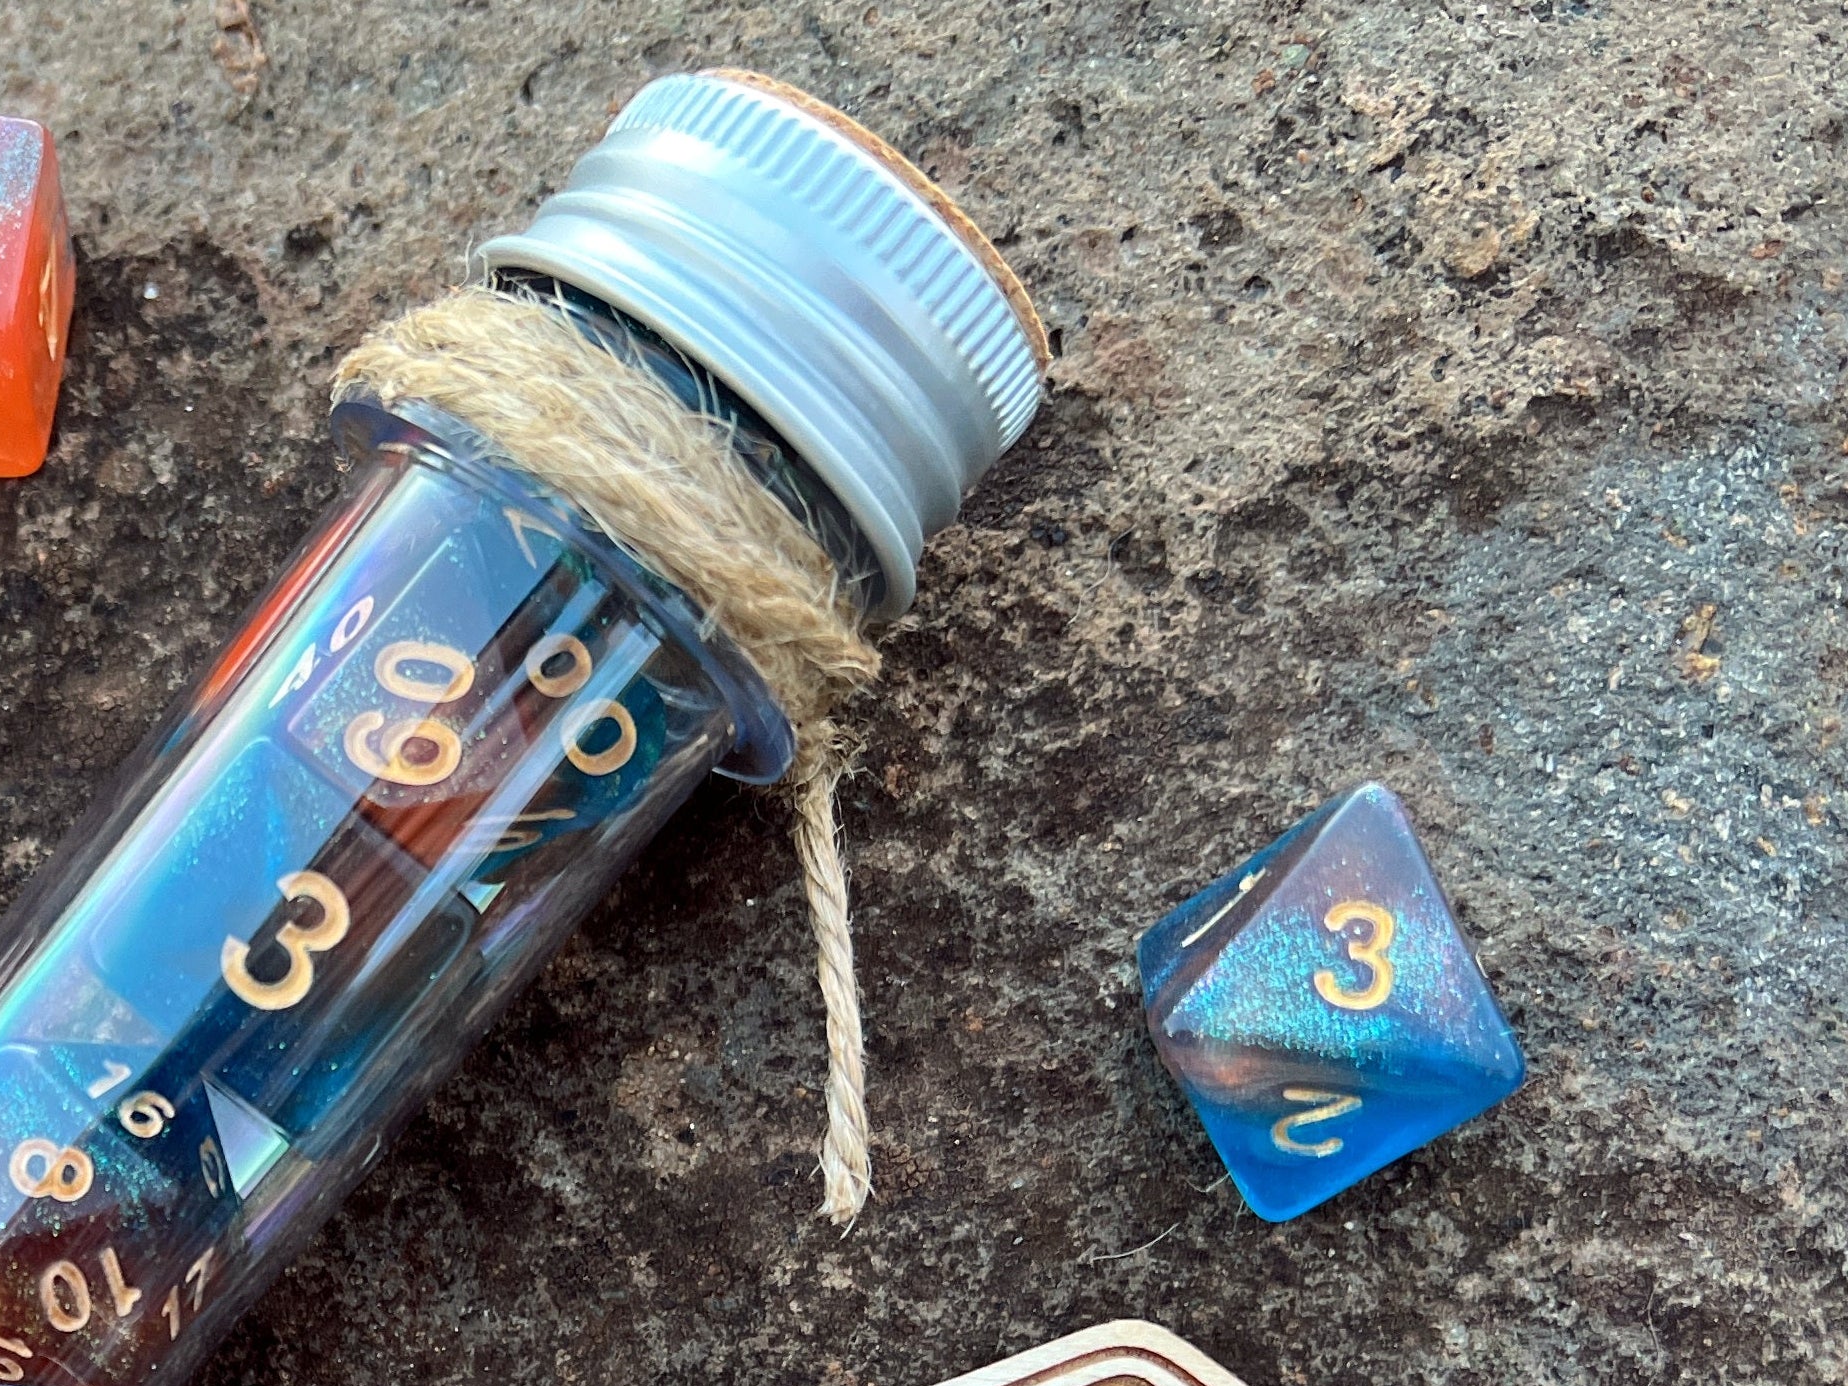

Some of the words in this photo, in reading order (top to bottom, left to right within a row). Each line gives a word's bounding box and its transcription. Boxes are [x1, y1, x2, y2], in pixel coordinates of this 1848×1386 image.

[344, 640, 475, 787] 60
[221, 870, 351, 1011] 3
[1313, 900, 1394, 1010] 3
[9, 1138, 95, 1203] 8
[1270, 1087, 1362, 1157] 2
[41, 1247, 142, 1334] 10
